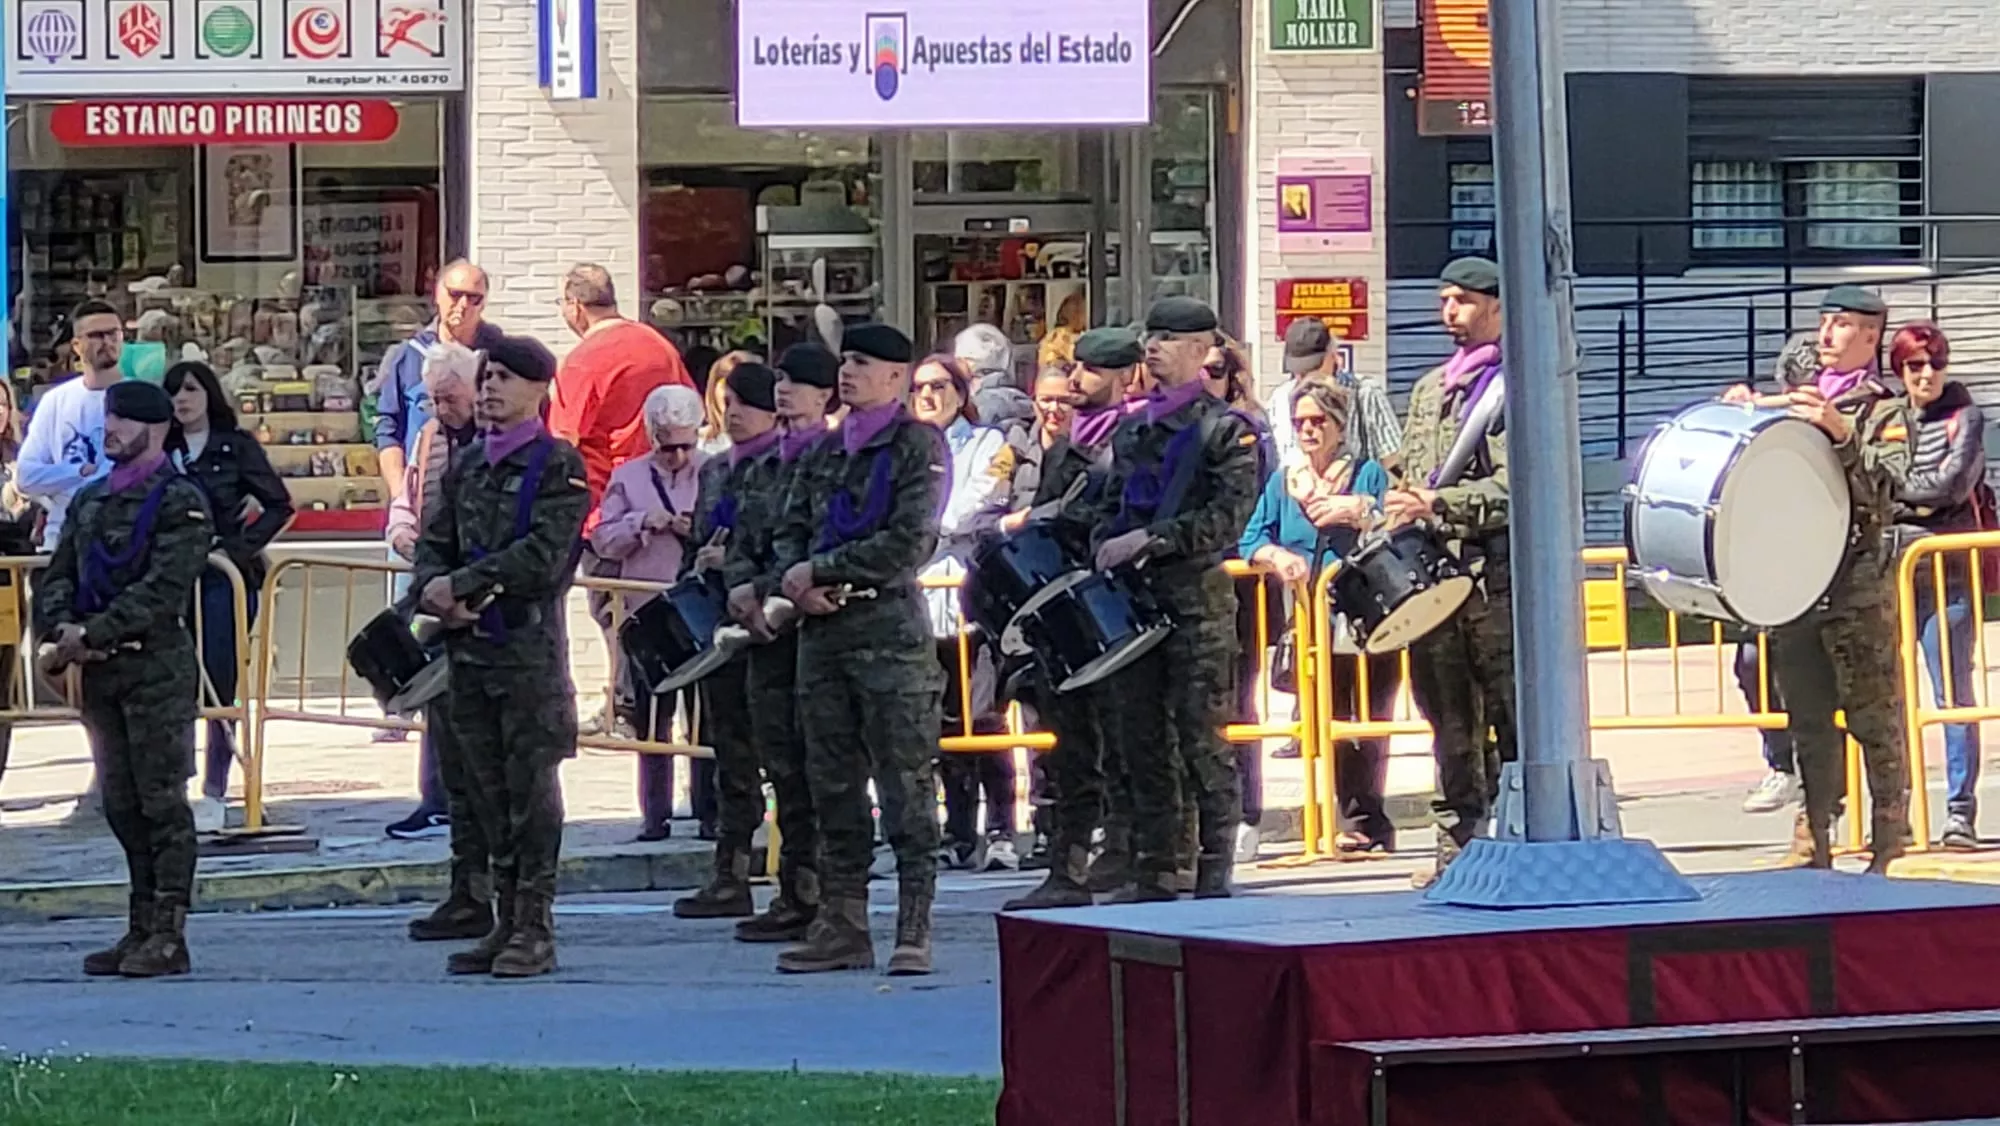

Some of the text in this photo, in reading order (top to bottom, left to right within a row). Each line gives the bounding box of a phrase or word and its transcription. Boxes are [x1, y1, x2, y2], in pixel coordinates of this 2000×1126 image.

[1286, 22, 1357, 46] MOLINER
[754, 31, 1132, 74] Loterías y Apuestas del Estado
[307, 74, 371, 86] Receptor
[86, 103, 361, 136] ESTANCO PIRINEOS
